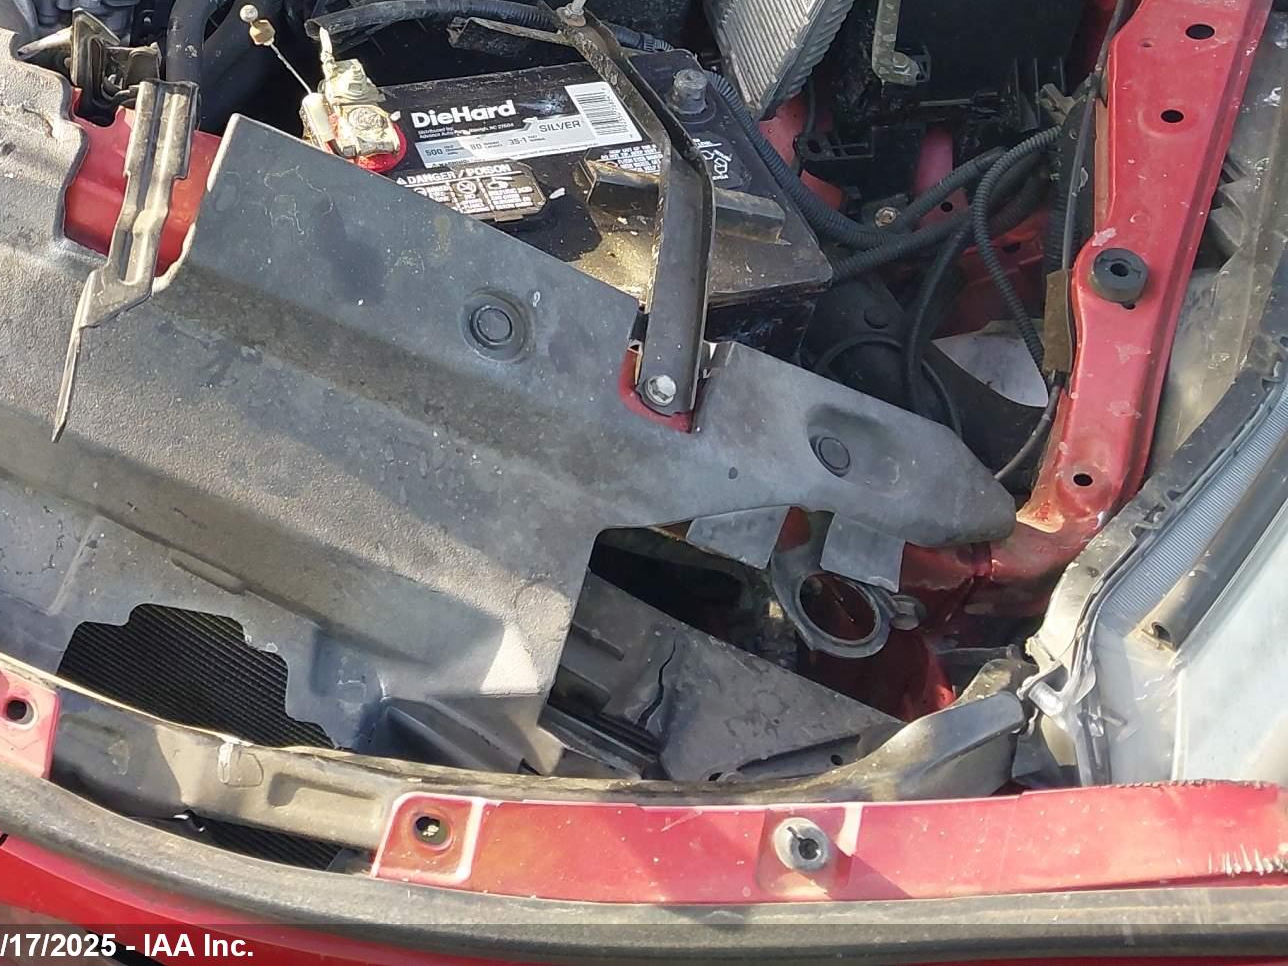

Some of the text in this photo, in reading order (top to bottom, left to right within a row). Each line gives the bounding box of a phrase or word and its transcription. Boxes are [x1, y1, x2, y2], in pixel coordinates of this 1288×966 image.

[411, 99, 517, 129] DieHard
[538, 120, 582, 133] SILVER
[425, 148, 443, 157] 500
[406, 171, 457, 185] DANGER
[465, 163, 512, 178] POISON
